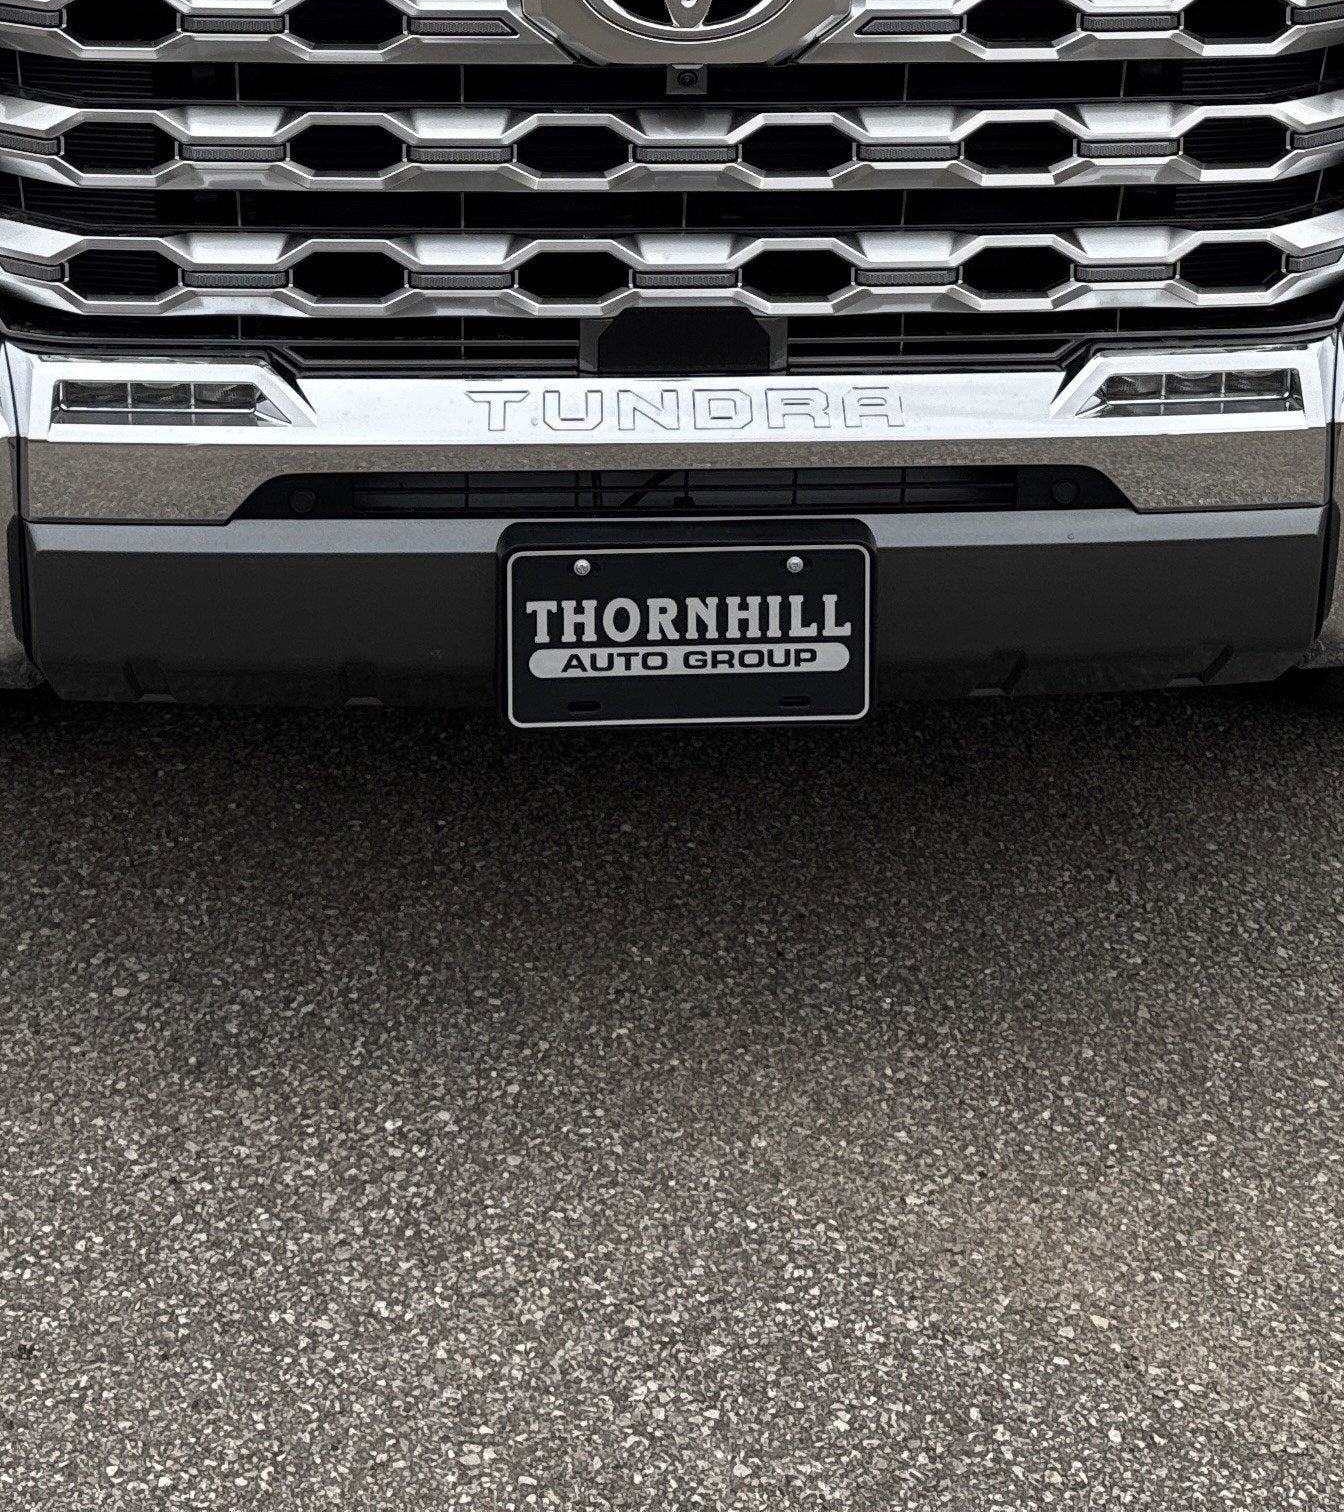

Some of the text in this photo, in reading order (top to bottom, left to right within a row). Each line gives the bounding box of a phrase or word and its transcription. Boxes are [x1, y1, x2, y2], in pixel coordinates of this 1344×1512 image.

[465, 386, 906, 432] TUNDRA
[525, 593, 852, 644] THORNHILL
[561, 648, 818, 673] AUTO GROUP
